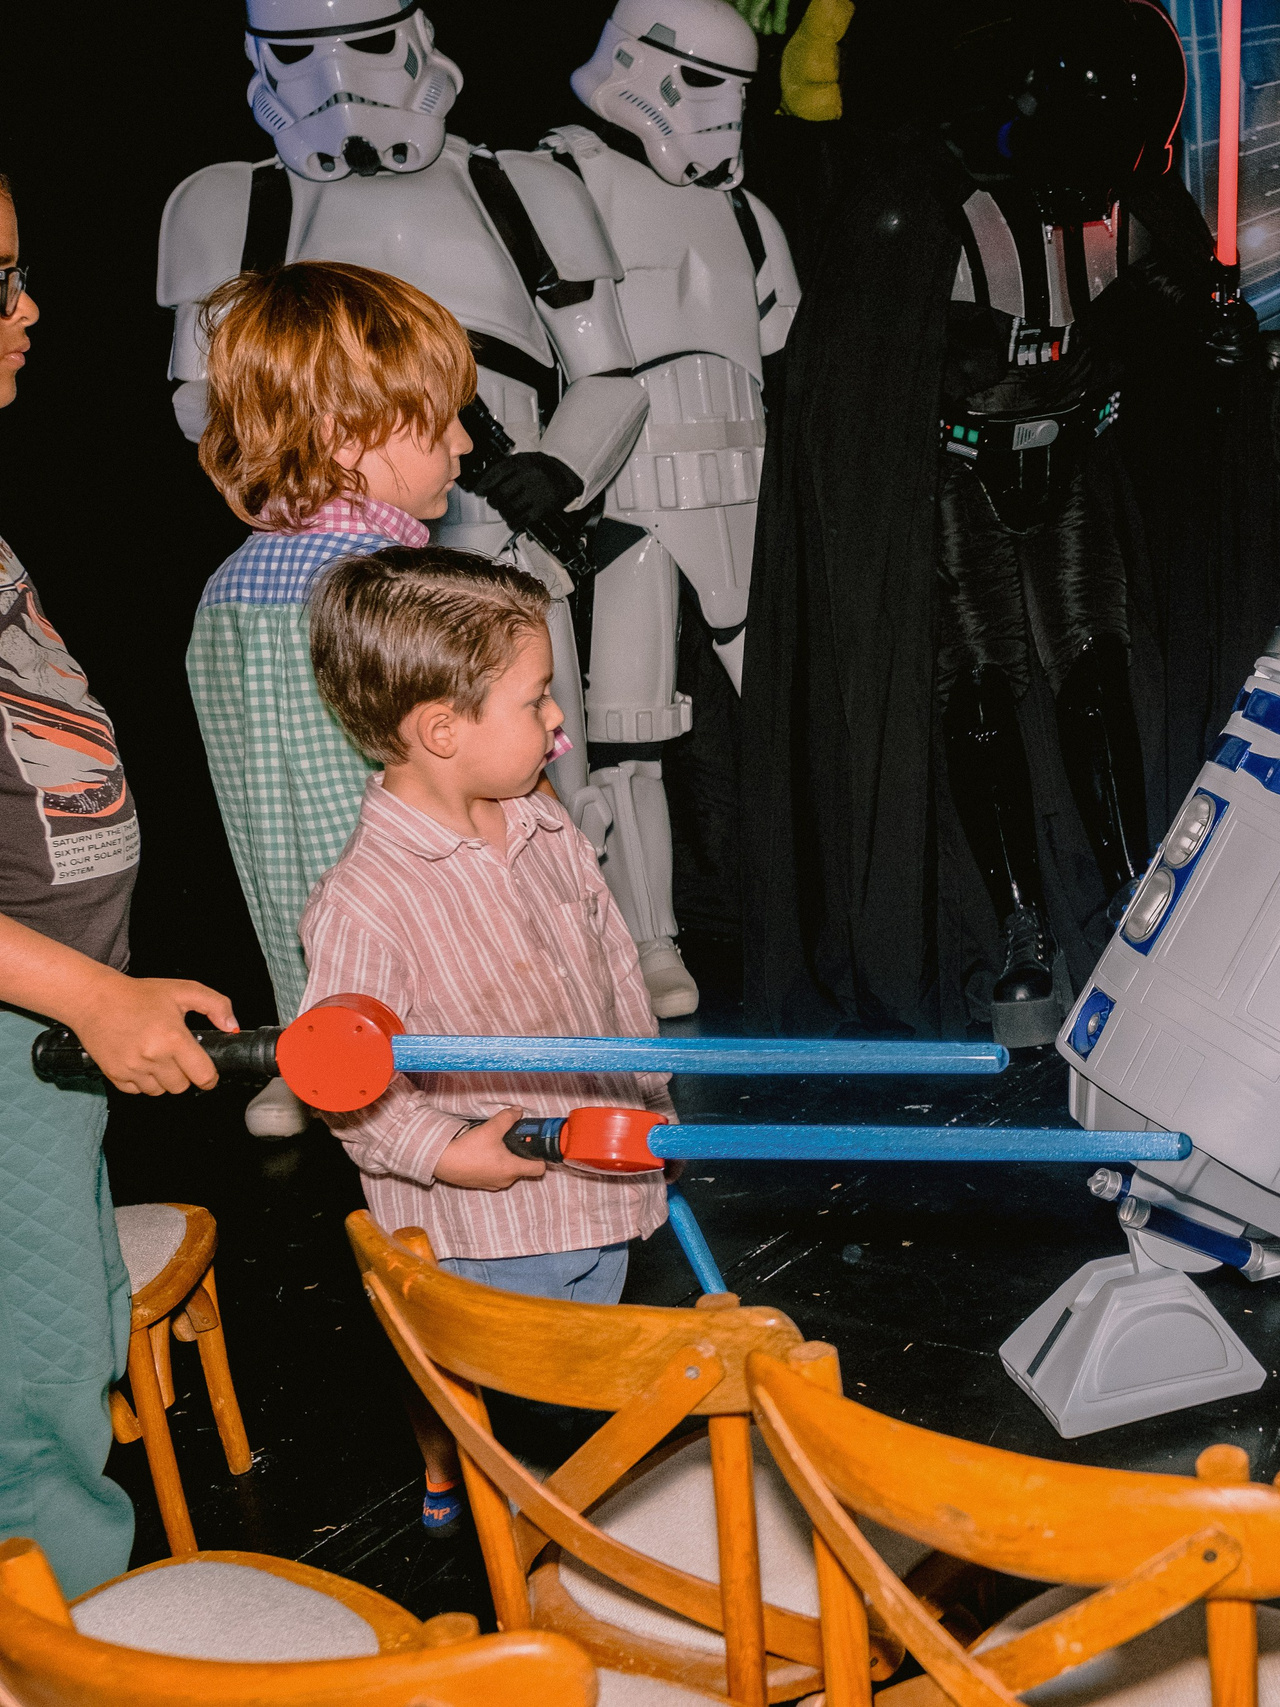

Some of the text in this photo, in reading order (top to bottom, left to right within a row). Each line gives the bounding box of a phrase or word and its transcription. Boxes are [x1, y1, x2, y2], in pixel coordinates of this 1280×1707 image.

[52, 834, 92, 848] SATURN
[106, 828, 121, 837] THE
[54, 846, 85, 859] SIXTH
[87, 837, 122, 852] PLANET
[69, 855, 91, 866] OUR
[94, 848, 122, 861] SOLAR
